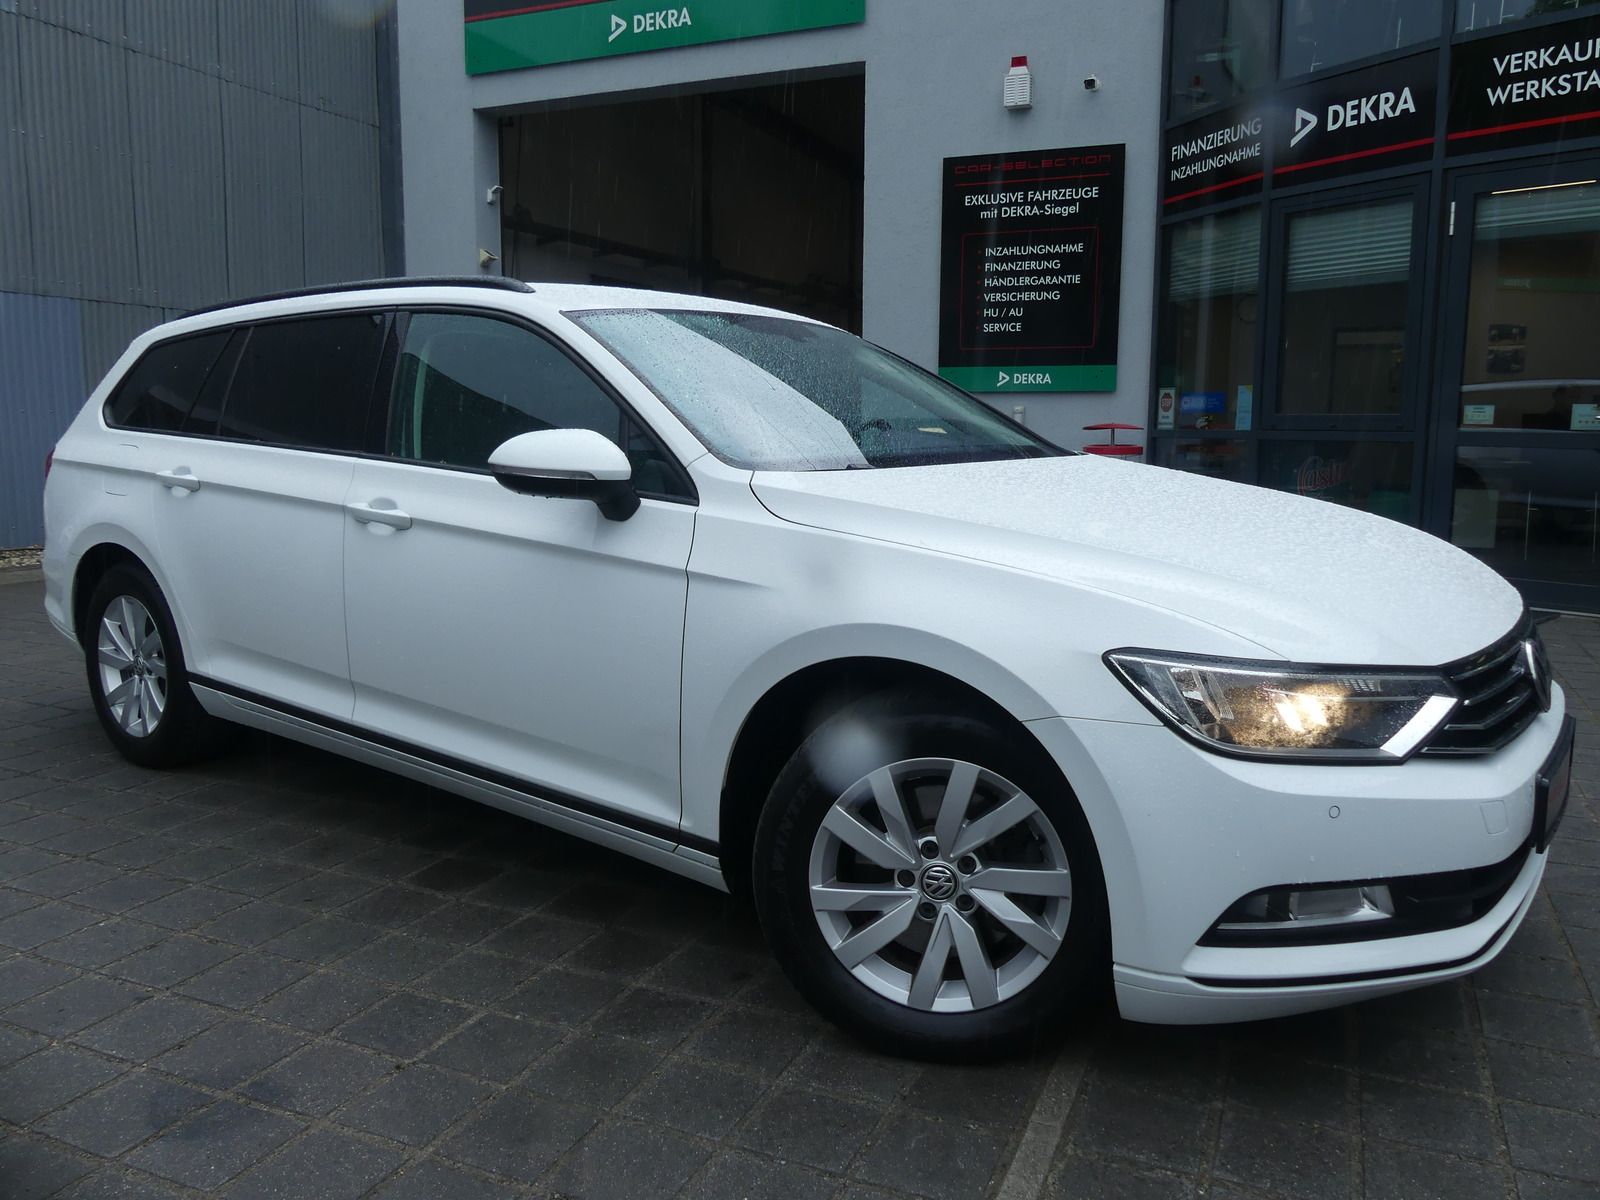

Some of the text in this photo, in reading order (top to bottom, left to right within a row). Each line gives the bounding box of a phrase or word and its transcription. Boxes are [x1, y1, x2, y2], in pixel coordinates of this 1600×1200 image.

[633, 7, 691, 34] DEKRA
[1326, 86, 1416, 132] DEKRA
[1170, 117, 1263, 162] FINANZIERUNG
[1170, 142, 1261, 182] INZAHLUNGNAHME
[964, 187, 1099, 206] EXKLUSIVE FAHRZEUGE
[980, 203, 1080, 219] mit DEKRA-Siegel
[985, 243, 1084, 257] INZAHLUNGNAHME
[985, 260, 1061, 272] FINANZIERUNG
[984, 274, 1081, 287] HÄNDLERGARANTIE
[984, 291, 1061, 302] VERSICHERUNG
[983, 308, 999, 318] HU
[1008, 307, 1023, 317] AU
[983, 322, 1022, 332] SERVICE
[1013, 373, 1052, 384] DEKRA
